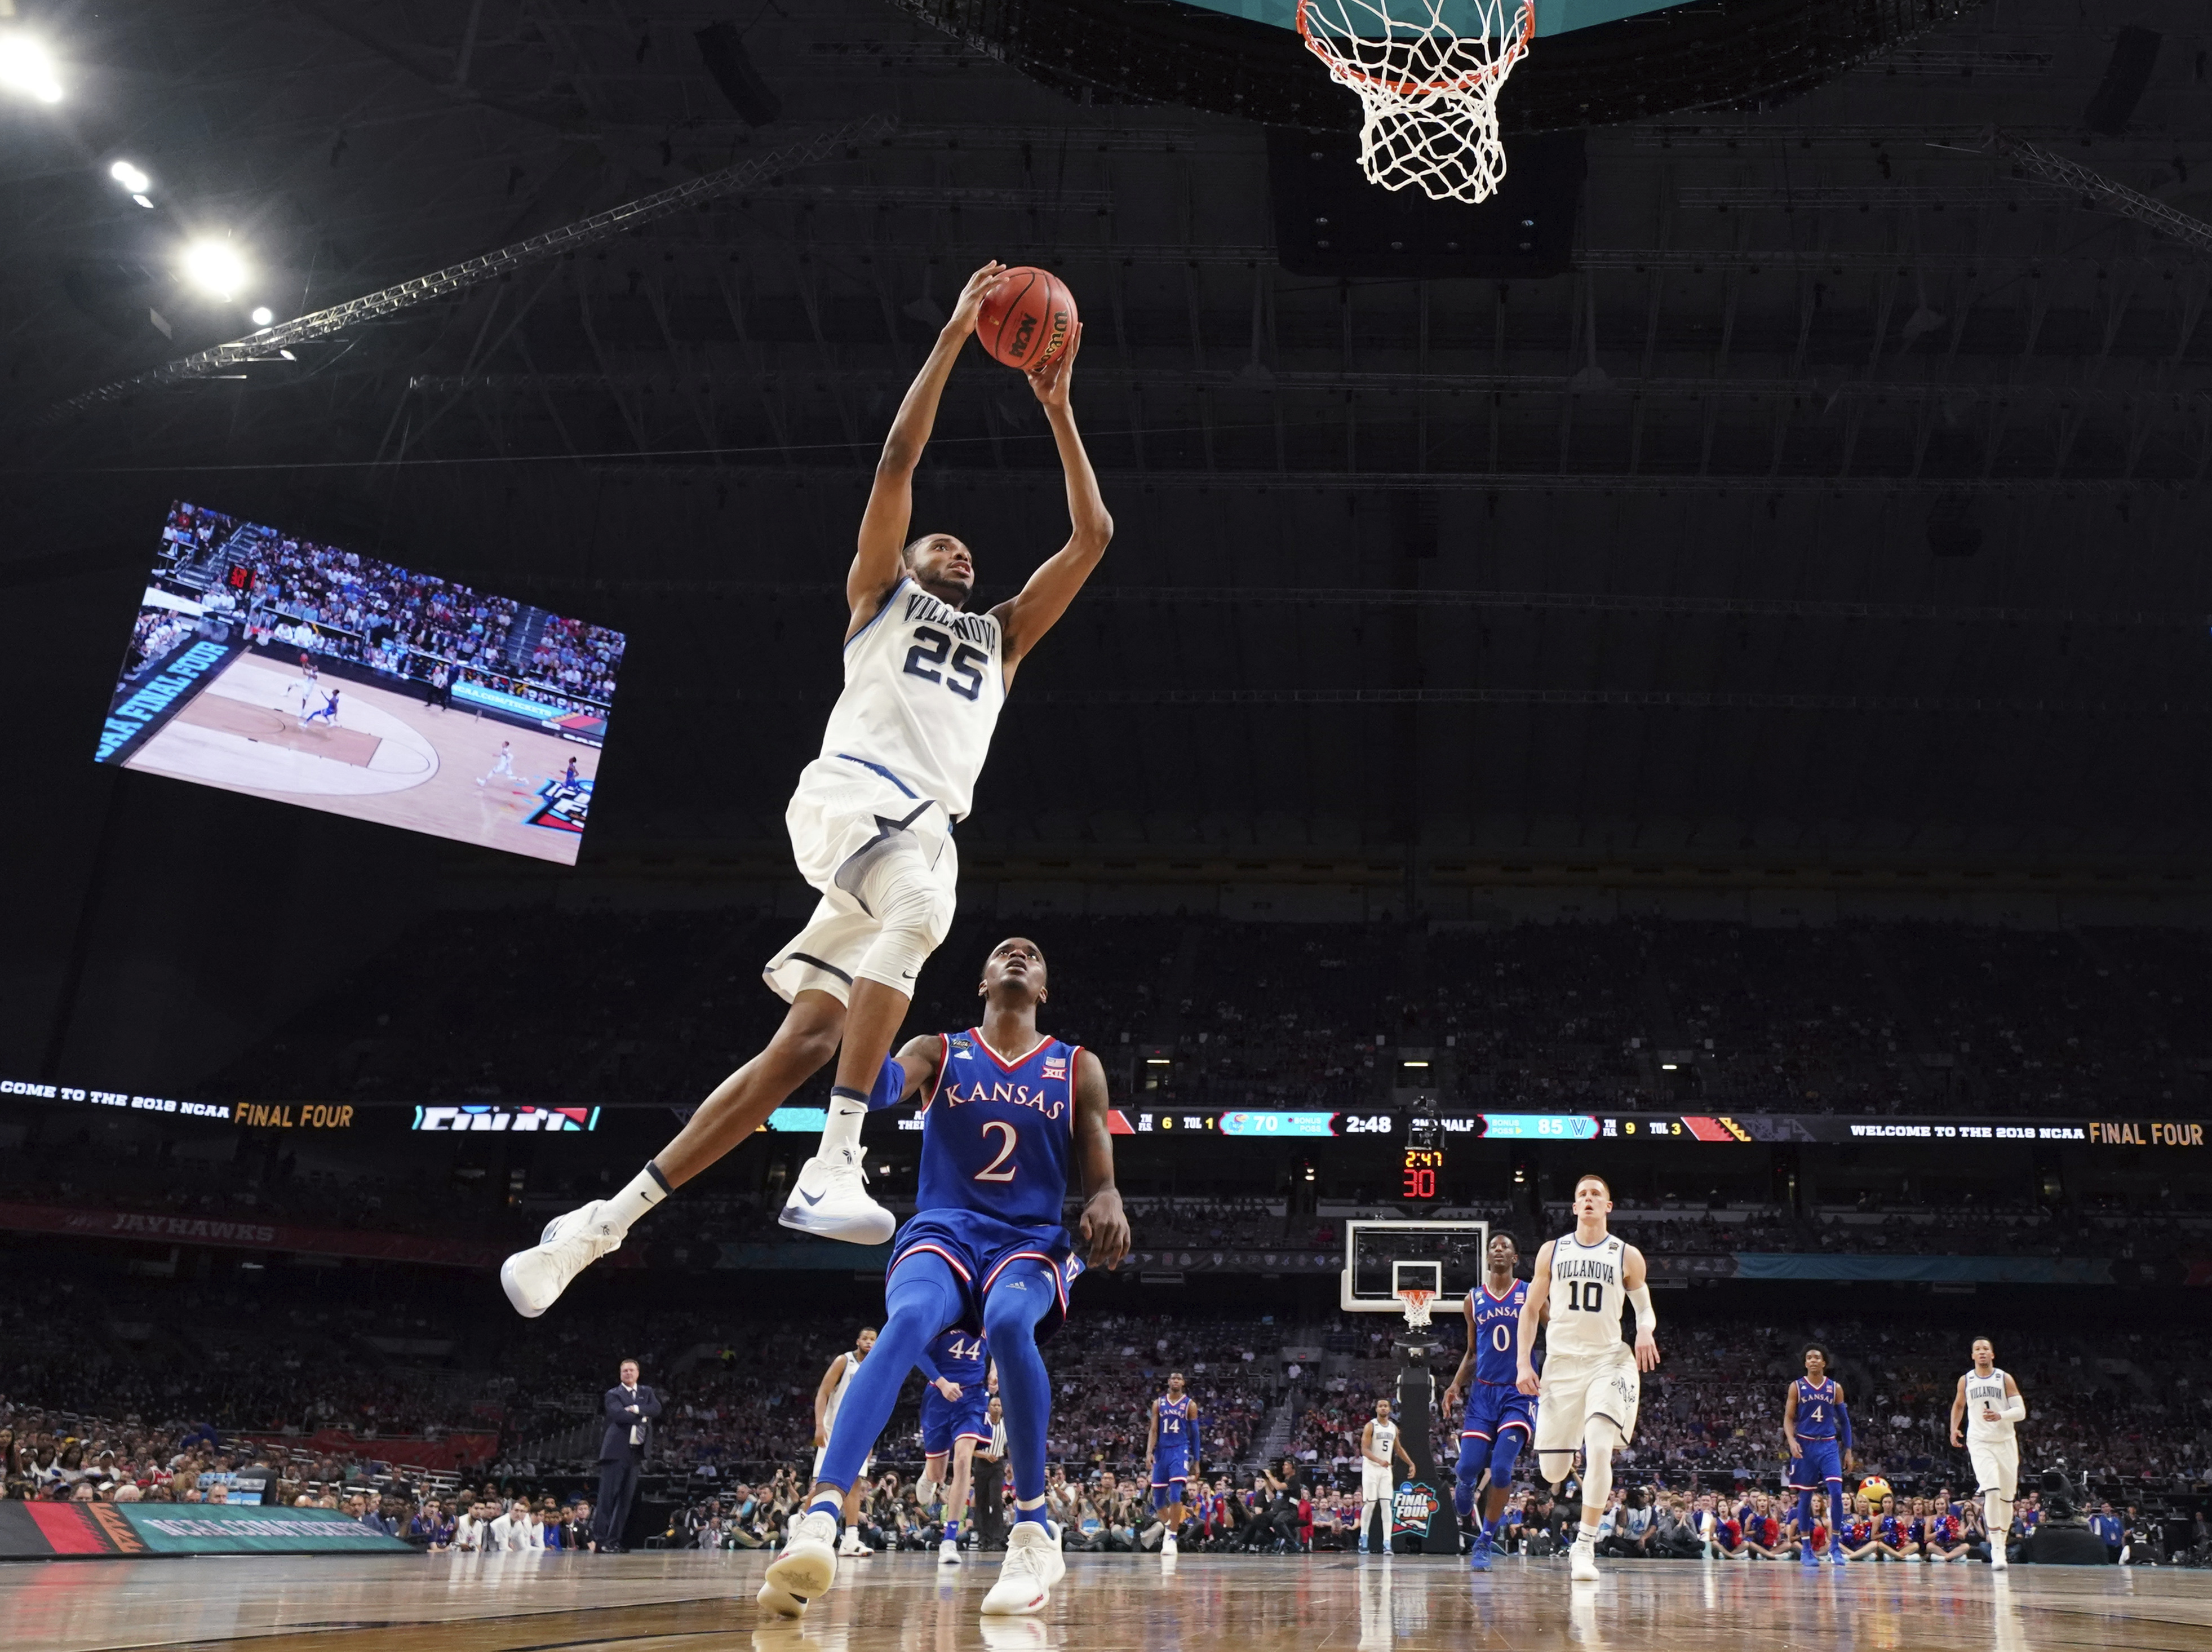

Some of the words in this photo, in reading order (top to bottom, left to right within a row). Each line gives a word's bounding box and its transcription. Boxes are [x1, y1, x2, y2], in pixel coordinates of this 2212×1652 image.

[902, 594, 996, 658] VILLNOVA
[903, 626, 988, 701] 25
[115, 675, 193, 722] FINAL
[166, 641, 229, 679] FOUR
[1, 1080, 56, 1098] COME
[61, 1088, 86, 1101] TO
[90, 1091, 127, 1106] THE
[131, 1096, 176, 1112] 2018
[180, 1102, 229, 1118] NCAA
[945, 1081, 1065, 1119] KANSAS
[234, 1102, 292, 1127] FINAL
[300, 1105, 353, 1128] FOUR
[1162, 1117, 1172, 1130] 6
[1183, 1117, 1202, 1129] TOL
[1205, 1117, 1213, 1130] 1
[1254, 1115, 1278, 1132] 70
[1346, 1116, 1391, 1133] 2:48
[1441, 1119, 1474, 1132] HALF
[1538, 1119, 1563, 1134] 85
[1625, 1122, 1635, 1135] 9
[1650, 1123, 1668, 1135] TOL
[1672, 1123, 1681, 1135] 3
[1850, 1125, 1931, 1137] WELCOME
[1934, 1126, 1956, 1137] TO
[1959, 1127, 1992, 1138] THE
[1996, 1127, 2036, 1139] 2018
[2039, 1128, 2085, 1139] NCAA
[2089, 1122, 2147, 1145] FINAL
[2151, 1123, 2204, 1145] FOUR
[974, 1120, 1017, 1181] 2
[1405, 1151, 1442, 1168] 2:47
[1403, 1169, 1435, 1197] 30
[112, 1212, 275, 1241] JAYHAWKS
[1557, 1259, 1615, 1286] VILLANOVA
[1568, 1281, 1603, 1313] 10
[1477, 1306, 1519, 1325] KANSA
[1492, 1324, 1510, 1352] 0
[948, 1337, 981, 1361] 44
[1801, 1393, 1834, 1405] KANSAS
[1970, 1385, 2002, 1401] VILLANOVA
[1811, 1405, 1824, 1423] 4
[1162, 1418, 1180, 1433] 14
[1382, 1441, 1389, 1452] 5
[1394, 1493, 1428, 1508] FINAL
[1396, 1505, 1429, 1519] FOUR
